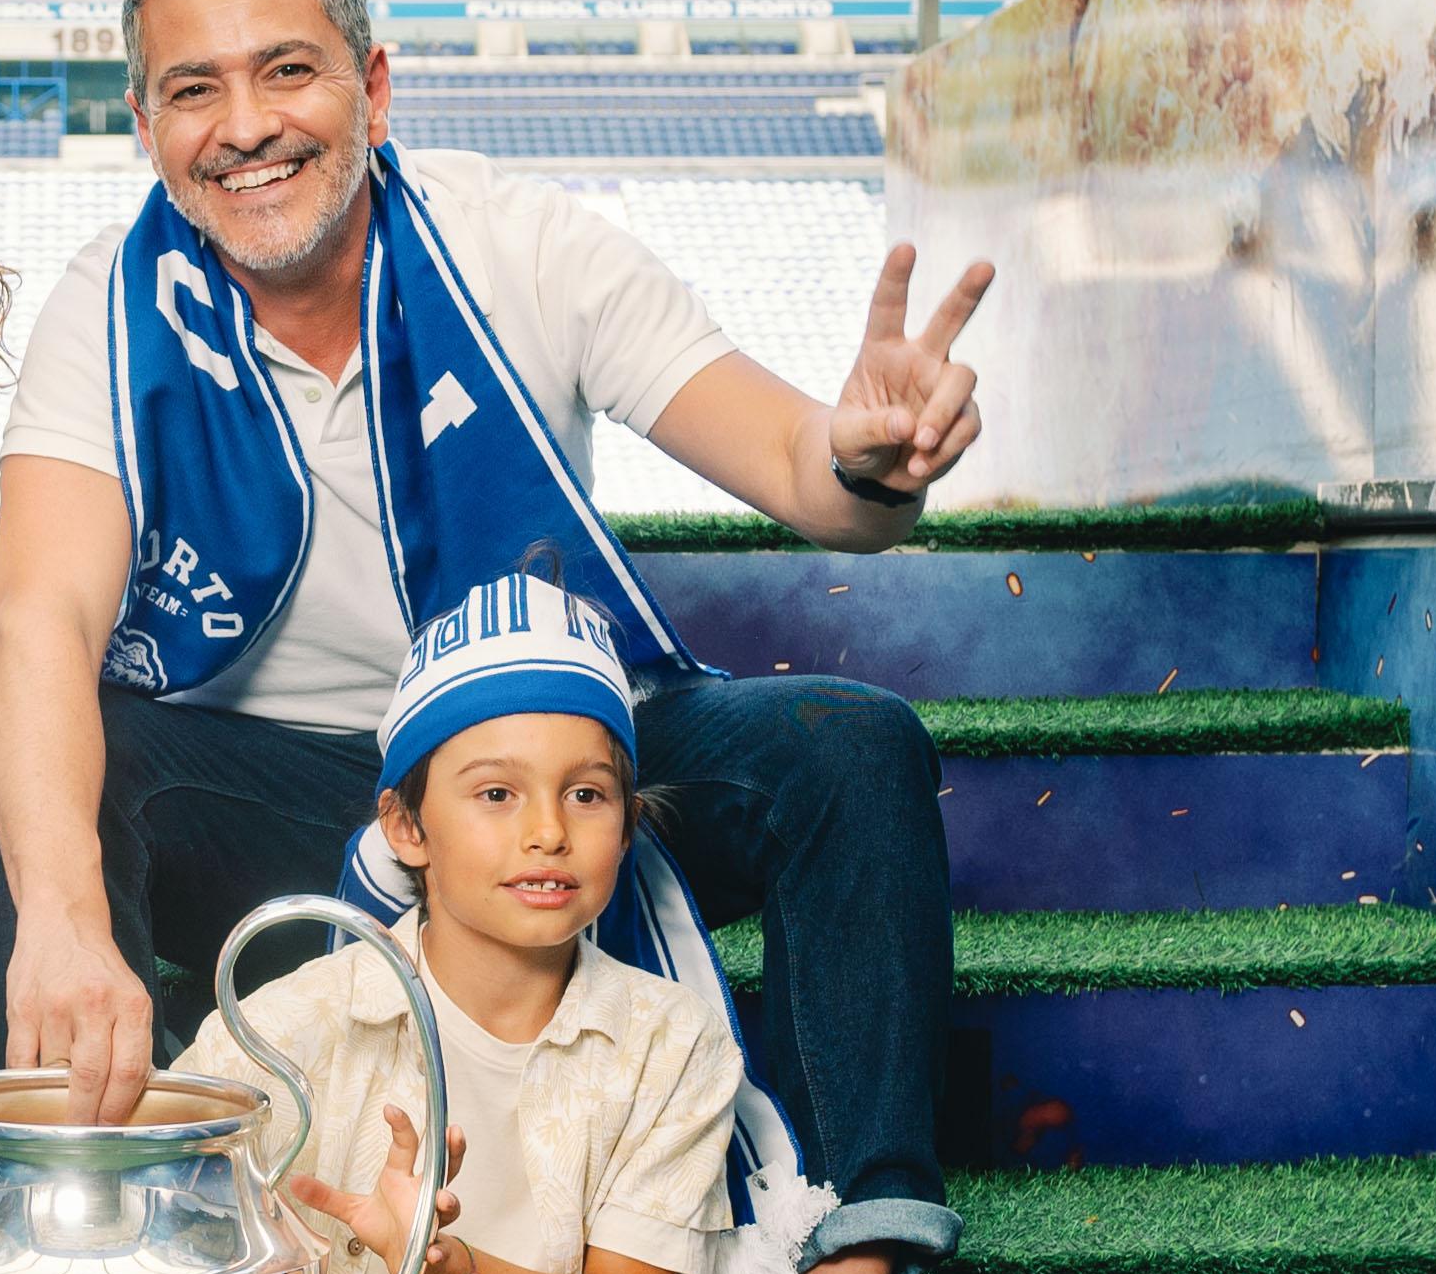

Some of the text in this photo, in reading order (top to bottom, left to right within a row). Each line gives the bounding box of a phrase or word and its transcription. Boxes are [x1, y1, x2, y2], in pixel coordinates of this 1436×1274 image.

[467, 0, 832, 19] FUTEBOL CLUBE DO PORTO
[52, 28, 116, 54] 189
